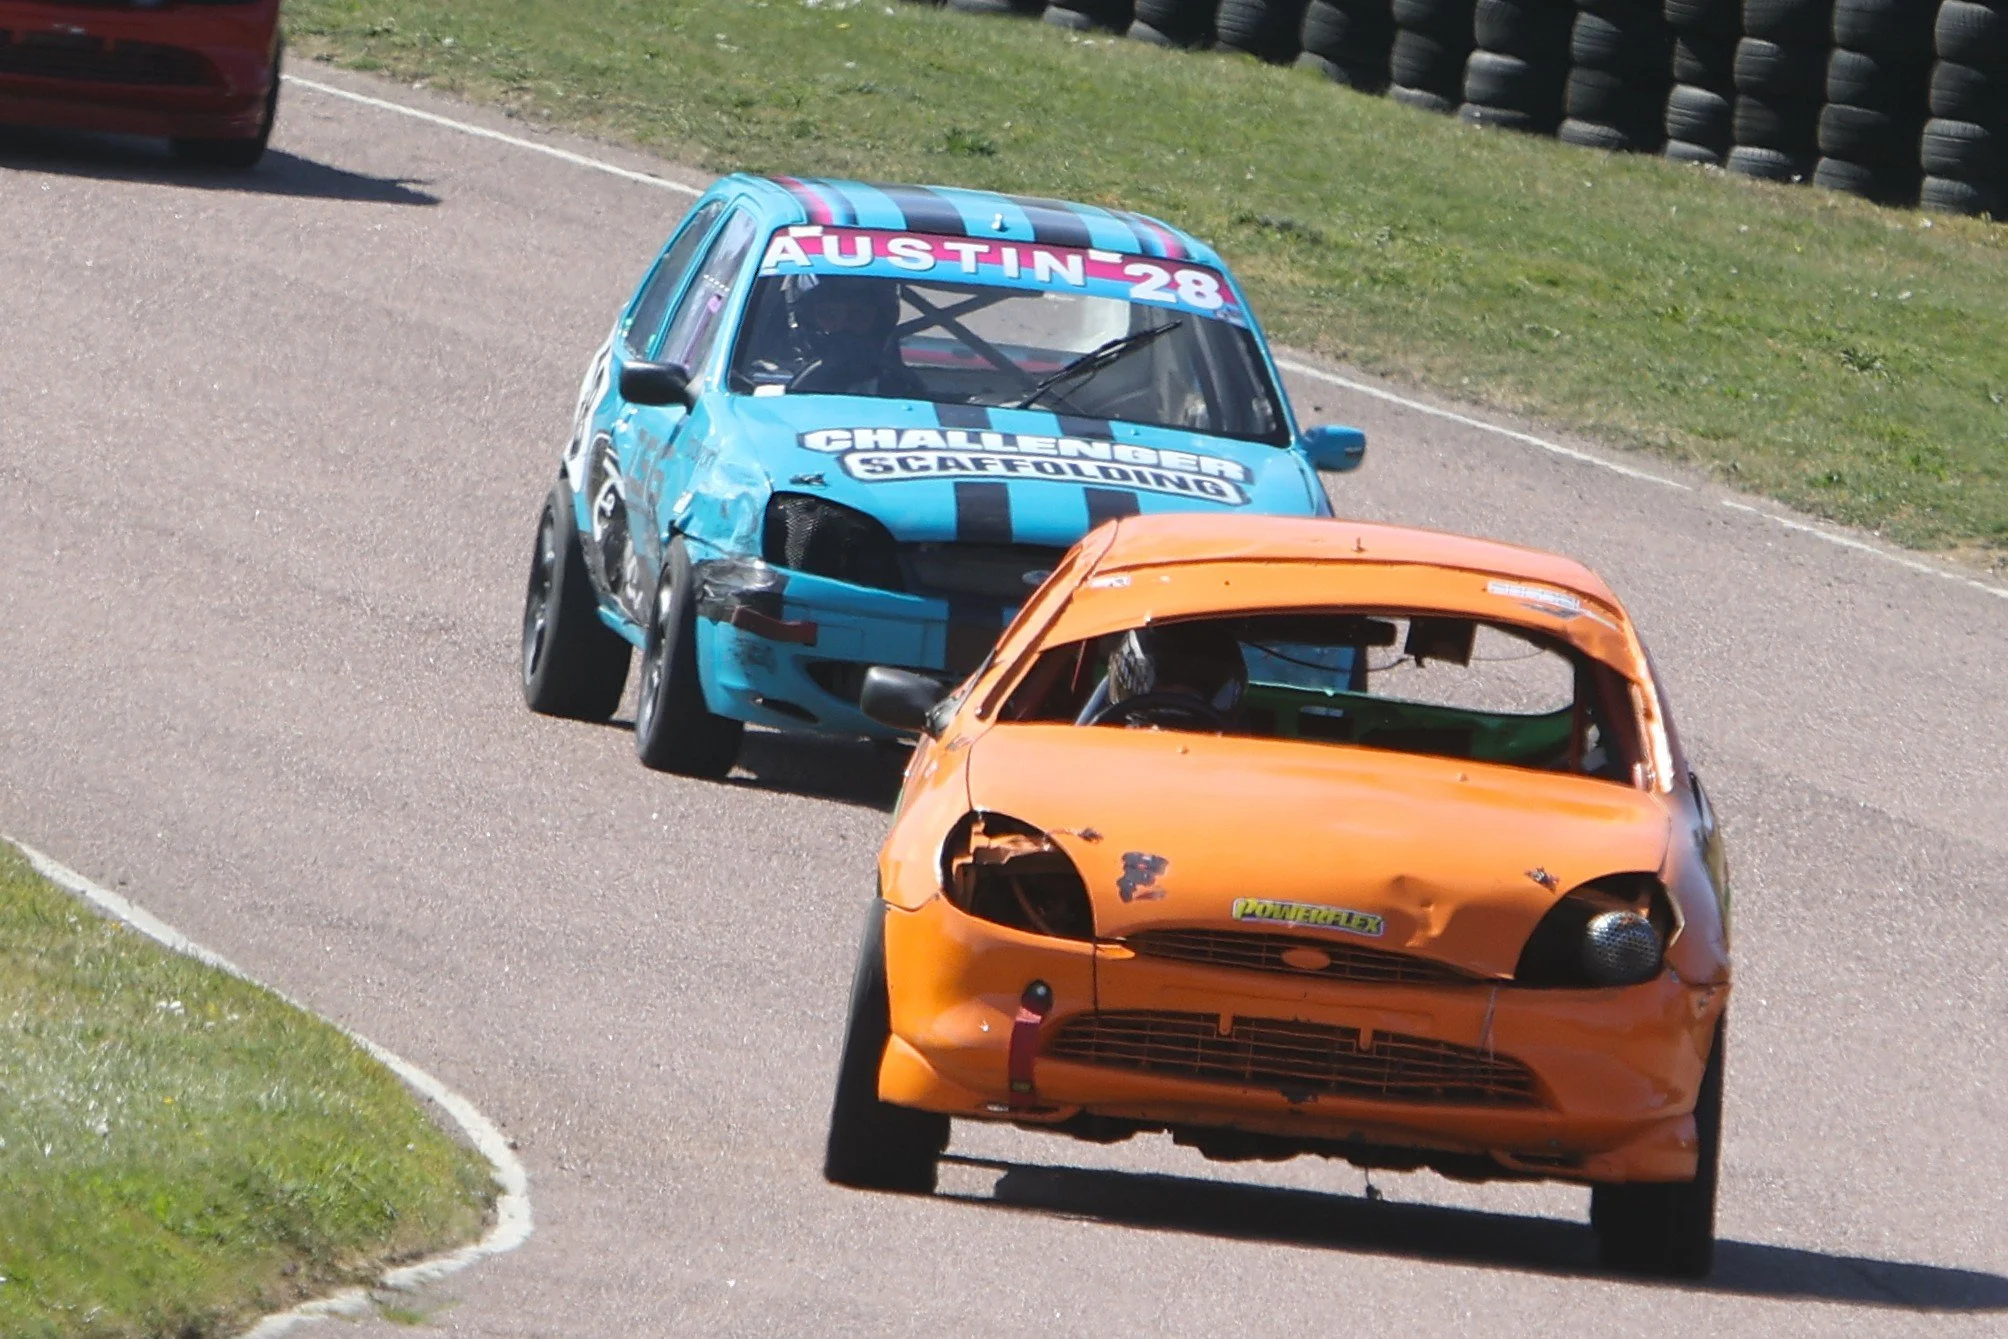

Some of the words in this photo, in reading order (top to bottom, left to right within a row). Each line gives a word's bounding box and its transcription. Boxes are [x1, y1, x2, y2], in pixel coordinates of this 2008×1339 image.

[762, 235, 1086, 286] AUSTIN
[1124, 264, 1223, 309] 28
[804, 429, 1245, 480] CHALLENGER
[863, 455, 1229, 498] SCAFFOLDING
[1235, 898, 1380, 932] POWERFLEX
